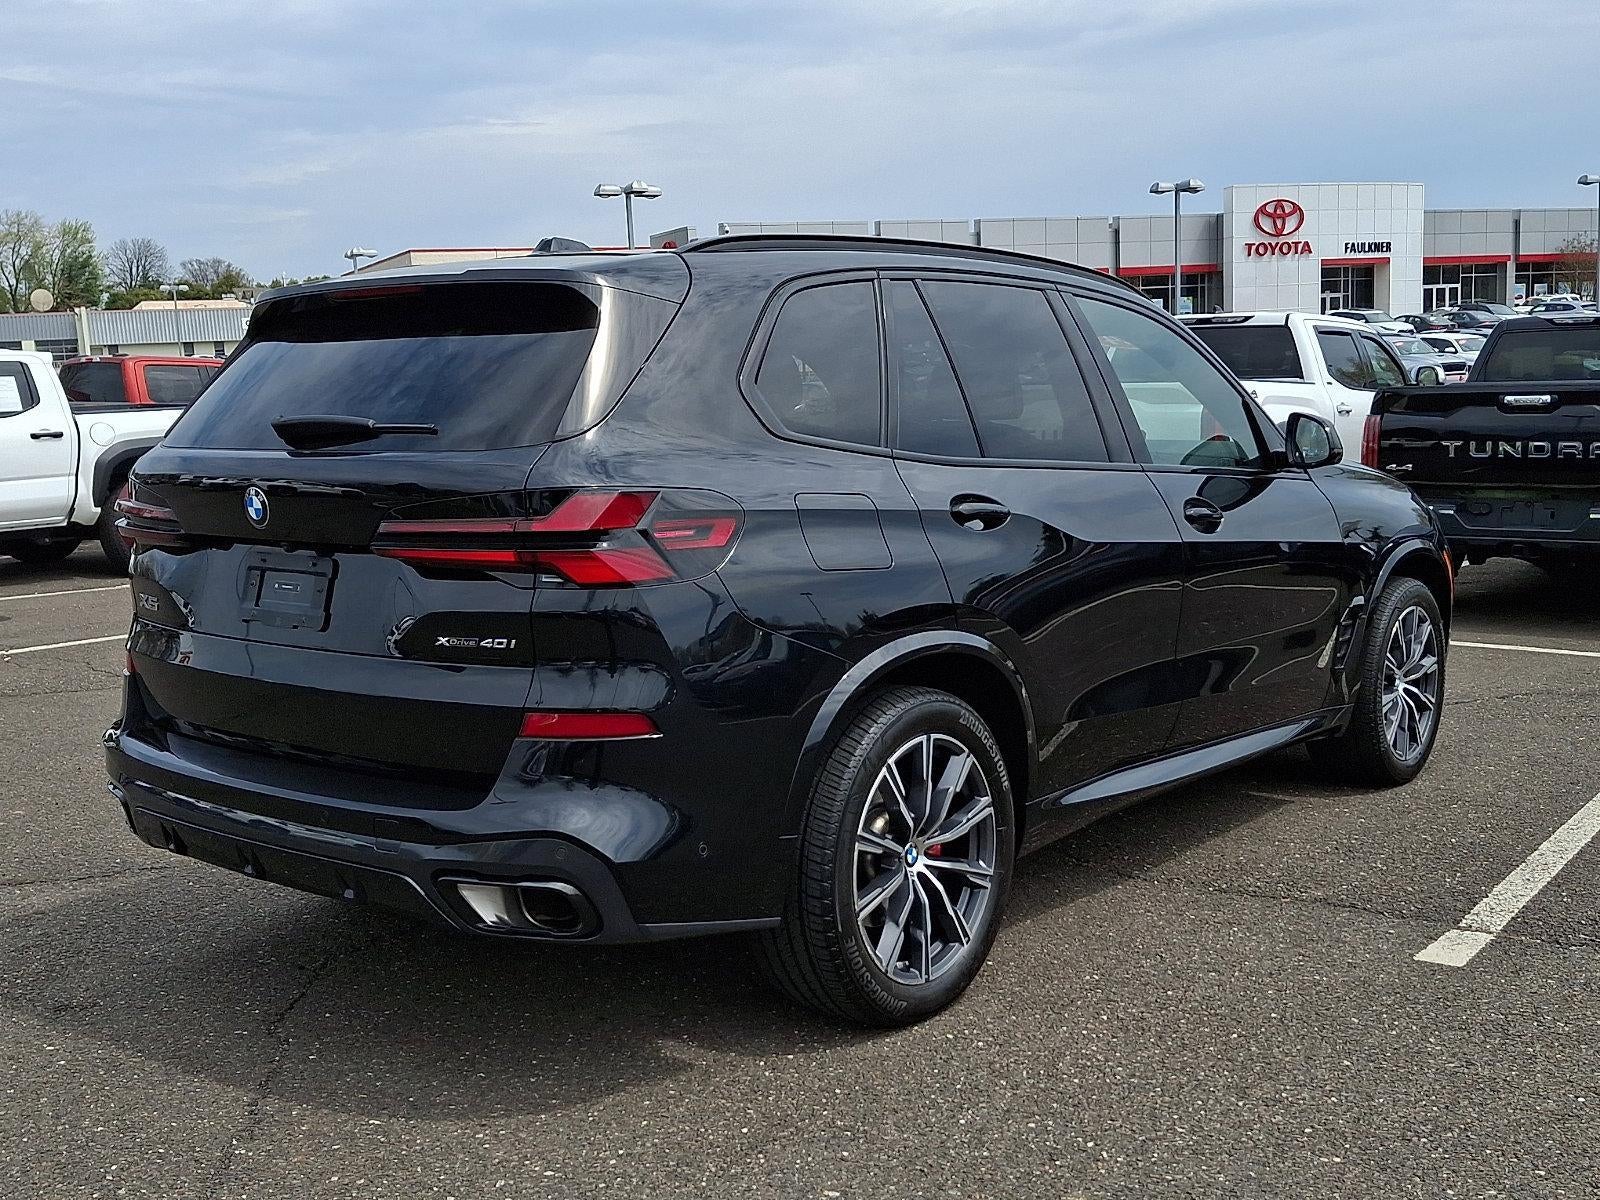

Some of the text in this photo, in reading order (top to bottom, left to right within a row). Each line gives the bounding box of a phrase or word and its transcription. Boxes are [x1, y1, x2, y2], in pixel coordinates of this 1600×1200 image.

[1245, 241, 1313, 257] TOYOTA
[1344, 241, 1392, 254] FAULKNER
[139, 592, 158, 611] X5
[959, 709, 1010, 792] BRIDGESTONE
